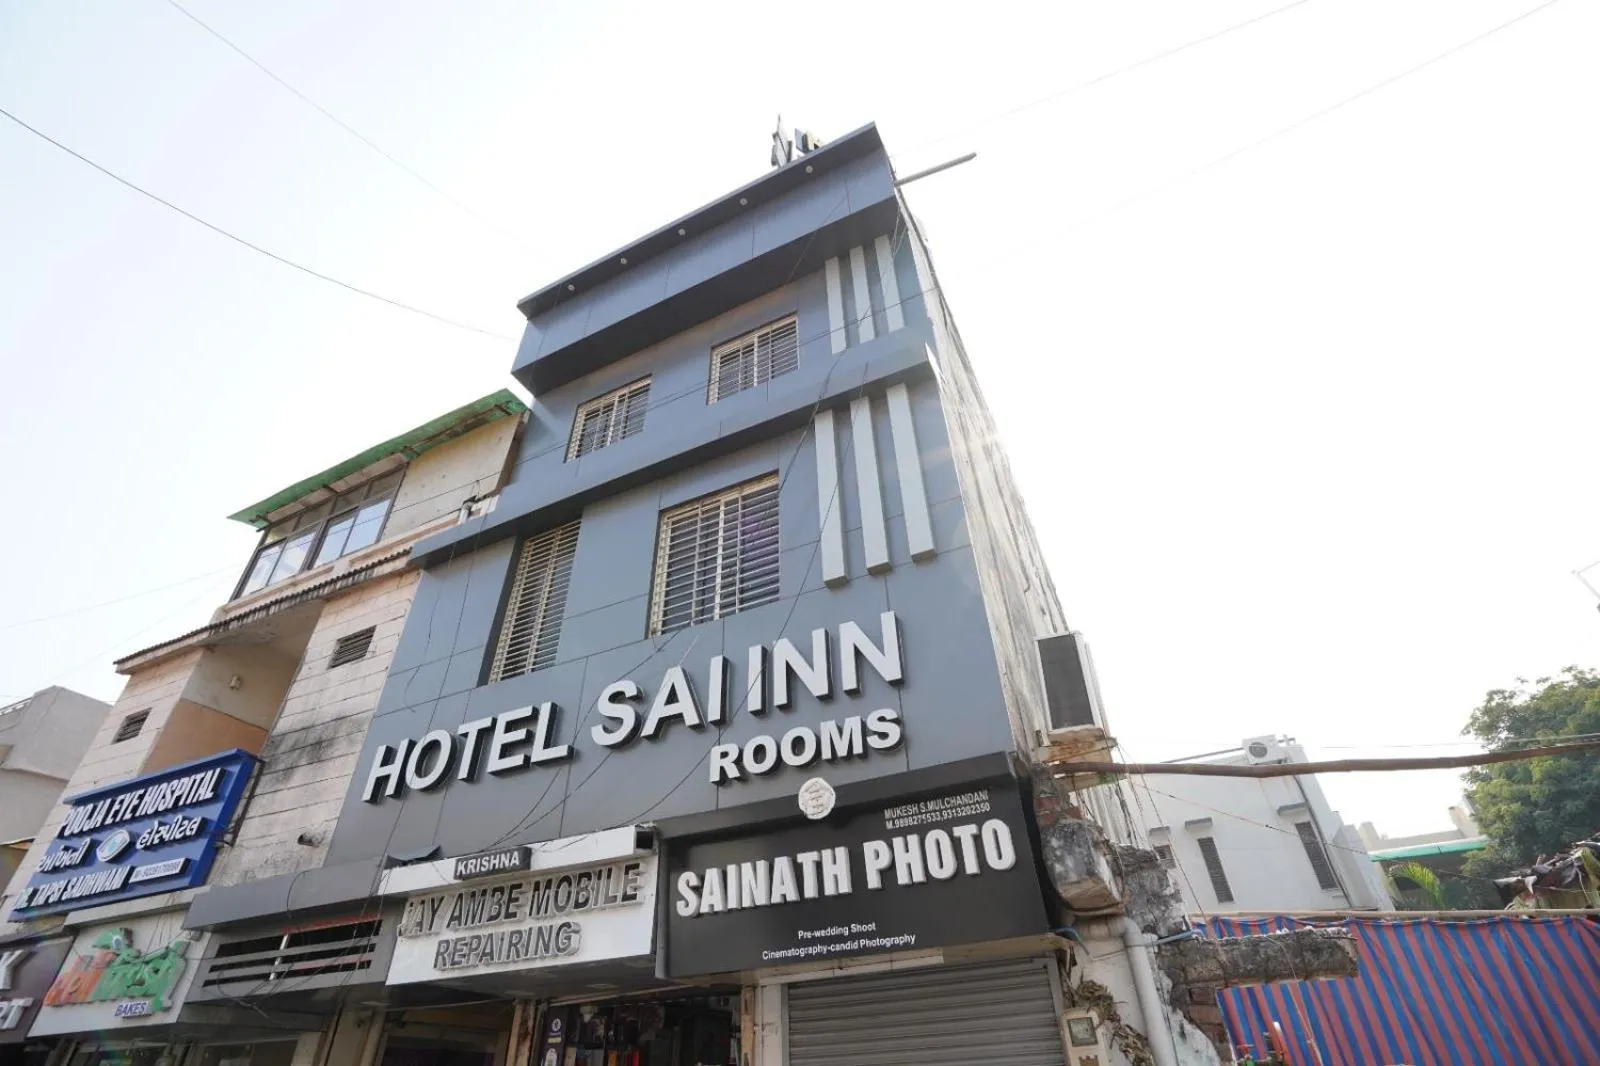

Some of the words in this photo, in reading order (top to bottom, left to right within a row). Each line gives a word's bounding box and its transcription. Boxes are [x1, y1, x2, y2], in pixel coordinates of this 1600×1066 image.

[361, 702, 569, 802] HOTEL
[591, 655, 725, 746] SAI
[748, 611, 902, 715] INN
[709, 708, 902, 783] ROOMS
[58, 799, 109, 838] POOJA
[105, 788, 144, 824] EYE
[138, 767, 221, 816] HOSPITAL
[884, 804, 919, 820] MUKESH
[456, 850, 521, 877] KRISHNA
[676, 846, 853, 918] SAINATH
[863, 818, 1016, 890] PHOTO
[446, 883, 524, 928] AMBE
[528, 862, 641, 917] MOBILE
[433, 921, 576, 969] REPAIRING
[762, 938, 859, 960] Cinematography-candid
[859, 933, 916, 949] Photography
[798, 924, 849, 939] Pre-wedding
[851, 922, 877, 933] Shoot
[114, 1003, 148, 1017] BAKES
